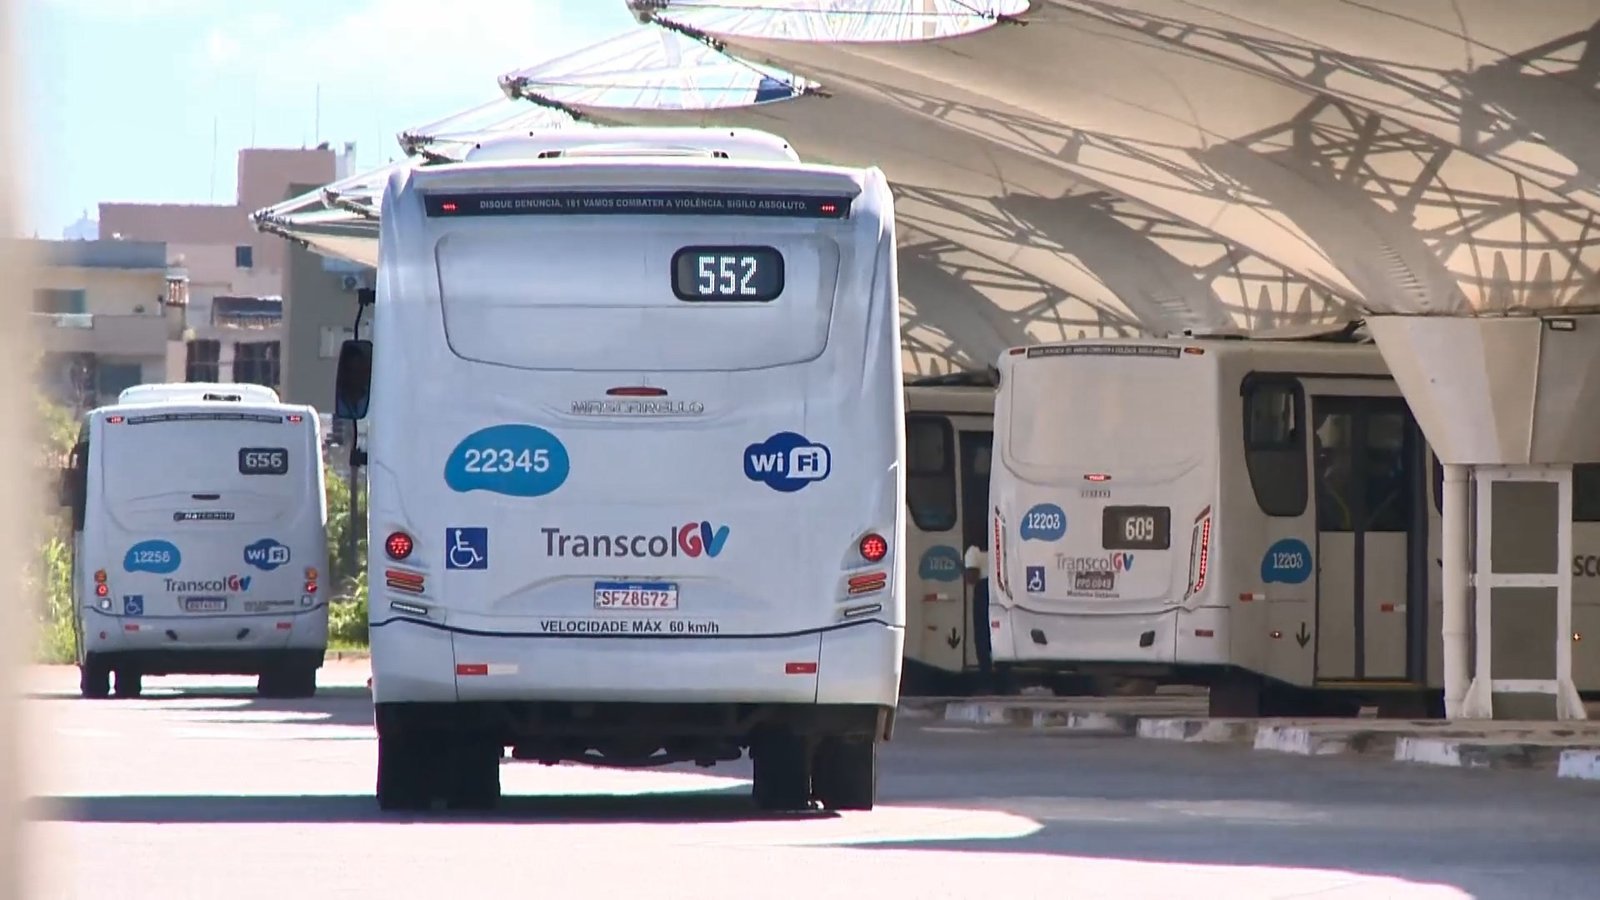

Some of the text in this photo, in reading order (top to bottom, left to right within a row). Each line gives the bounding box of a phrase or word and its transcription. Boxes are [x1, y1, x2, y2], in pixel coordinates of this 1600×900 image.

[480, 200, 512, 209] DISQUE
[583, 199, 613, 207] VAMOS
[616, 199, 664, 207] COMBATER
[665, 199, 673, 207] A
[727, 199, 756, 208] SIGILO
[698, 256, 757, 295] 552
[245, 452, 283, 467] 656
[464, 448, 550, 473] 22345
[1027, 513, 1061, 529] 12203
[1125, 517, 1155, 541] 609
[1272, 551, 1304, 569] 12203
[601, 590, 669, 607] SFZ8G72
[540, 618, 720, 633] VELOCIDADE MÁX 60 km/h
